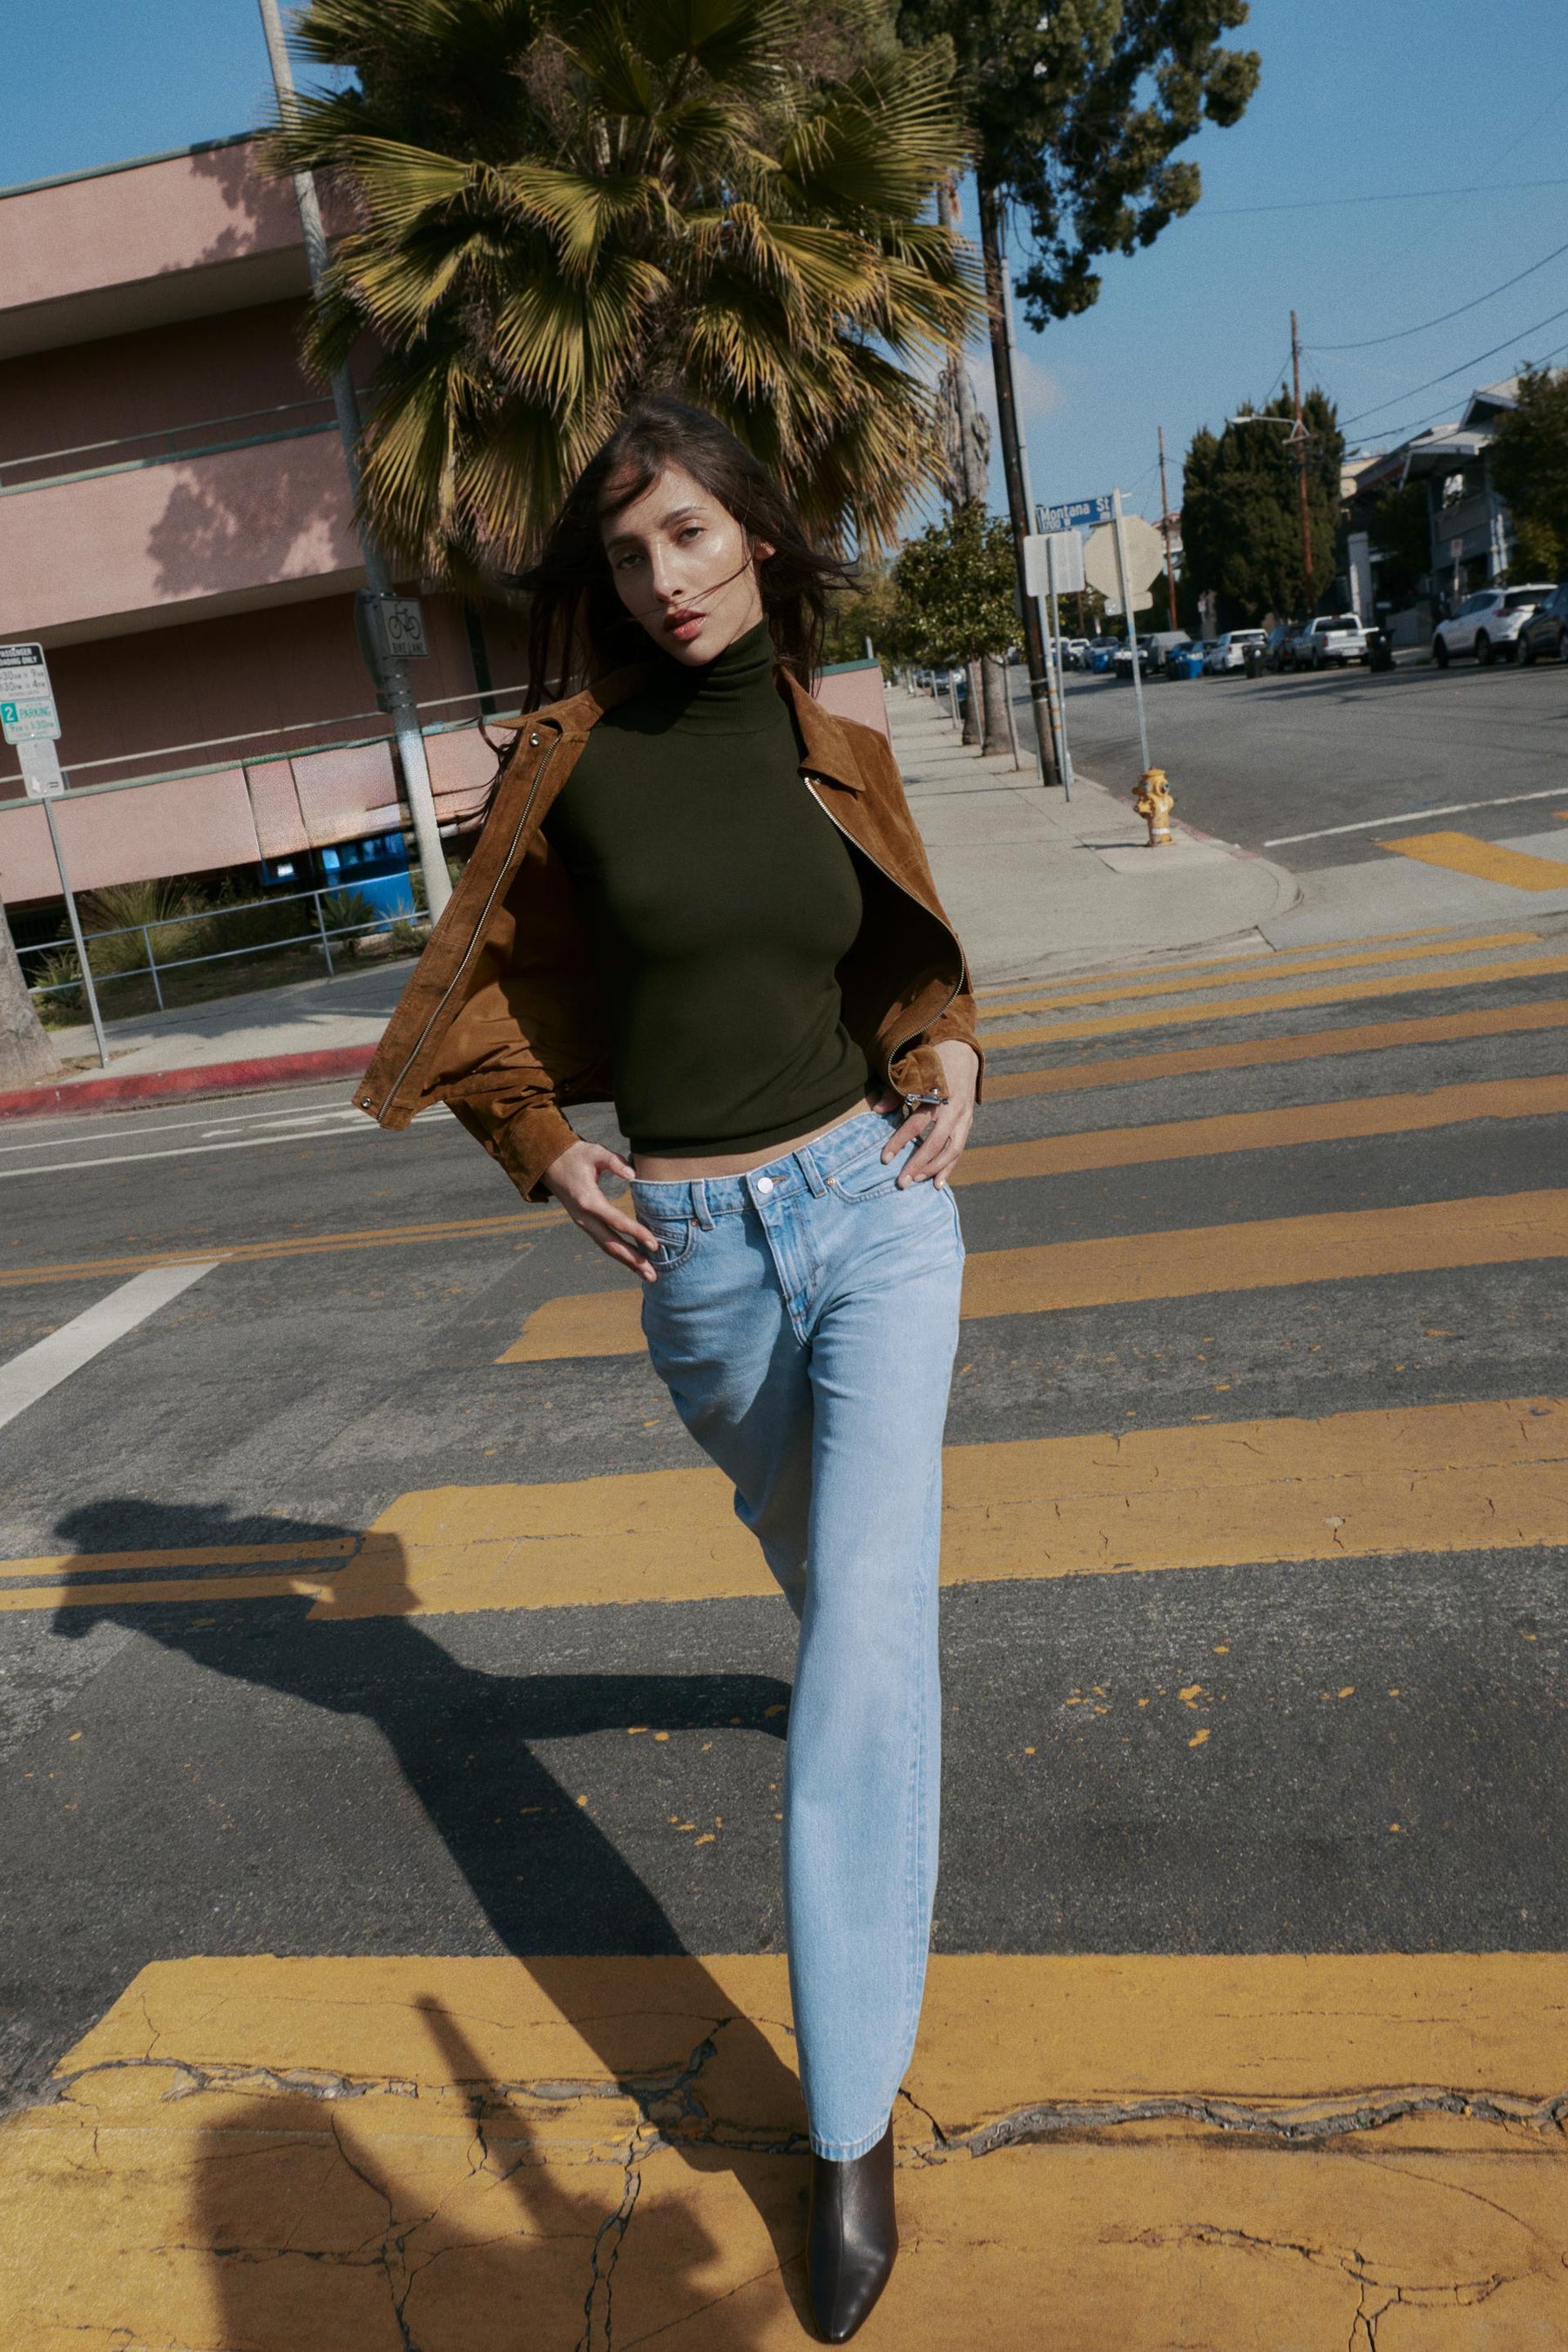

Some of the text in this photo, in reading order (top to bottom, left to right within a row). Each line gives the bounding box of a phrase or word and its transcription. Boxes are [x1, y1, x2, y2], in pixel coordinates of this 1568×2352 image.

[1040, 504, 1091, 521] Montana
[1096, 497, 1111, 512] St
[4, 706, 15, 721] 2
[19, 706, 52, 718] PARKING
